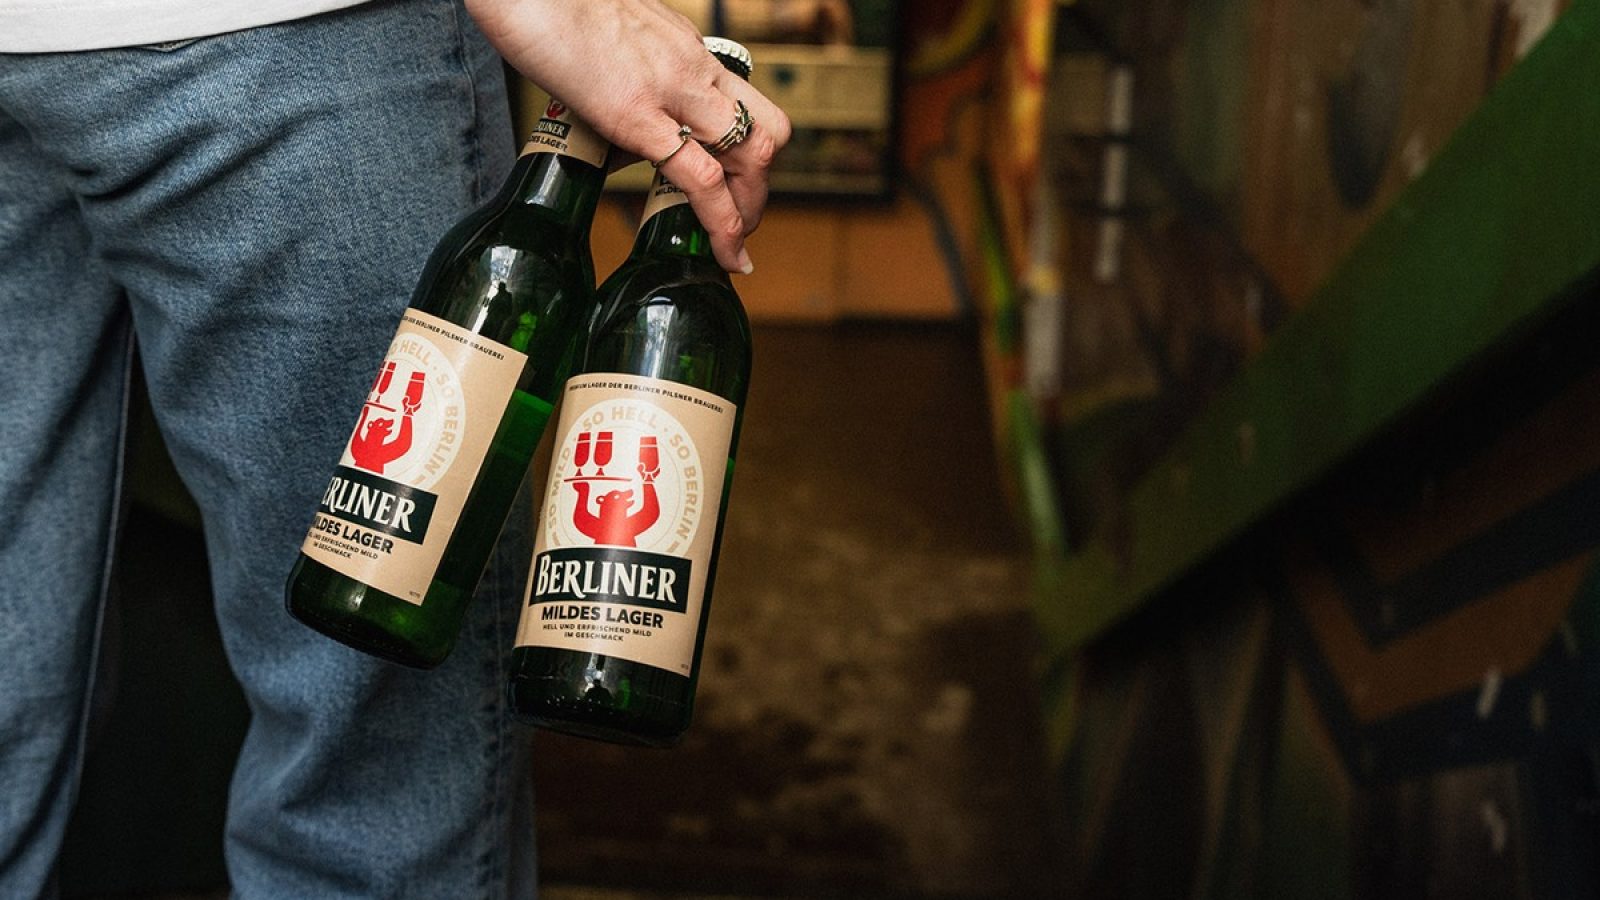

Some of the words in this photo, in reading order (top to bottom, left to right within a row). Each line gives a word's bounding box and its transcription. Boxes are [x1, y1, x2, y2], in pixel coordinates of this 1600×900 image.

[399, 338, 432, 366] HELL
[441, 330, 469, 345] PILSNER
[469, 341, 505, 361] BRAUEREI
[436, 373, 456, 398] SO
[624, 384, 661, 395] BERLINER
[662, 389, 693, 403] PILSNER
[694, 398, 724, 414] BRAUEREI
[582, 411, 605, 432] SO
[611, 405, 658, 430] HELL
[424, 405, 459, 475] BERLIN
[669, 433, 691, 461] SO
[551, 447, 571, 497] MILD
[676, 465, 698, 541] BERLIN
[342, 526, 394, 555] LAGER
[360, 549, 378, 560] MILD
[535, 553, 677, 605] BERLINER
[541, 605, 601, 622] MILDES
[606, 607, 664, 629] LAGER
[559, 623, 576, 631] UND
[577, 624, 631, 635] ERFRISCHEND
[632, 629, 652, 637] MILD
[575, 631, 624, 642] GESCHMACK
